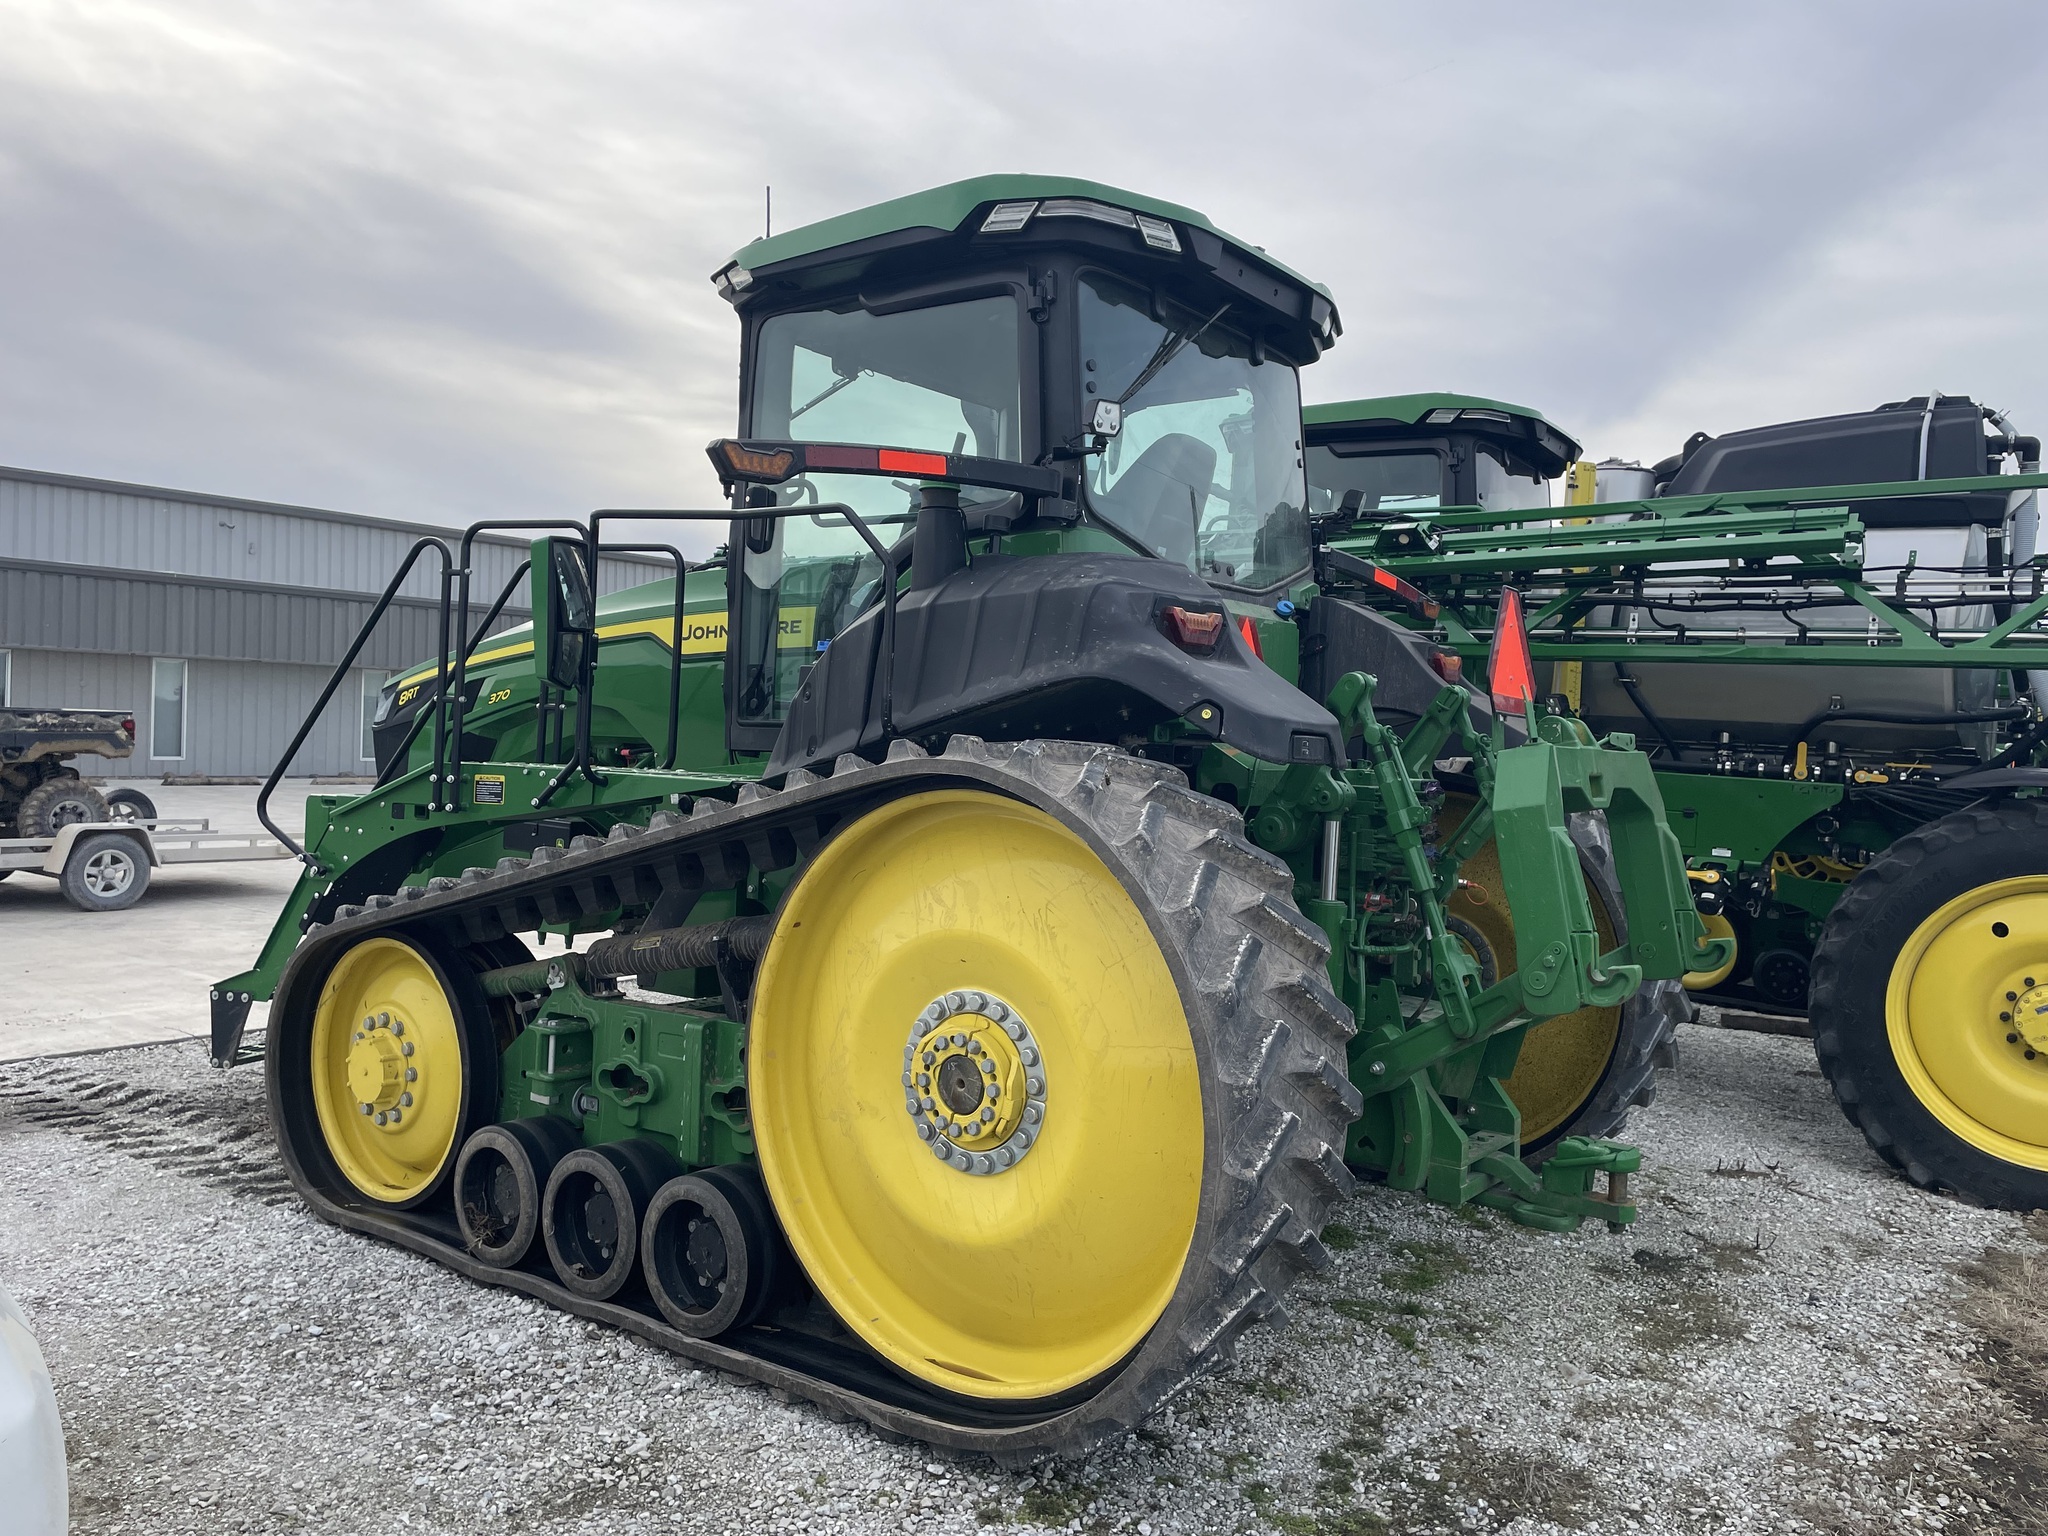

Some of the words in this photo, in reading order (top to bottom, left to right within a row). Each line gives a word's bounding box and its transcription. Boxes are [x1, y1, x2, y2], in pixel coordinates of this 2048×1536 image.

[682, 624, 728, 641] JOHN
[398, 685, 420, 705] 8RT
[488, 689, 511, 704] 370
